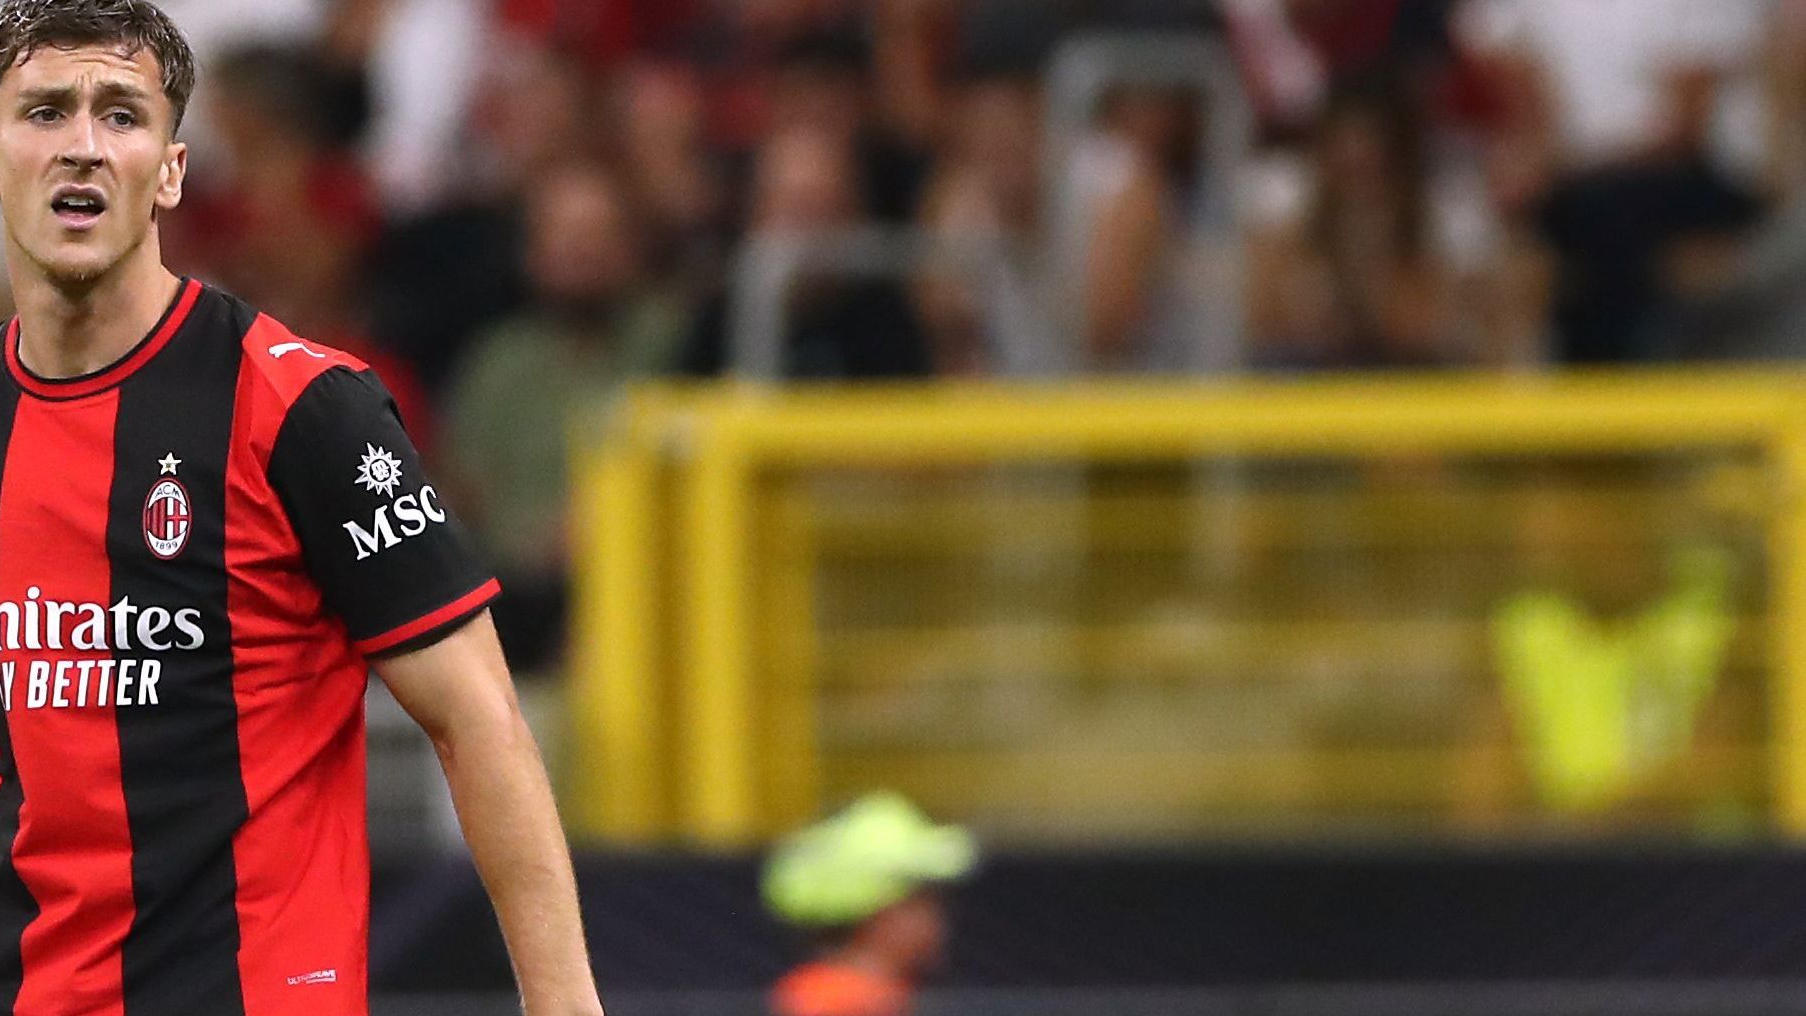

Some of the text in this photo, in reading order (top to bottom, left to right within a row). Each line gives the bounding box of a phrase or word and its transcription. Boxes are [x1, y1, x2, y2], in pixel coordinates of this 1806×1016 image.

[154, 484, 181, 499] ACM
[342, 485, 446, 561] MSC
[155, 540, 179, 551] 1899
[26, 659, 161, 709] BETTER
